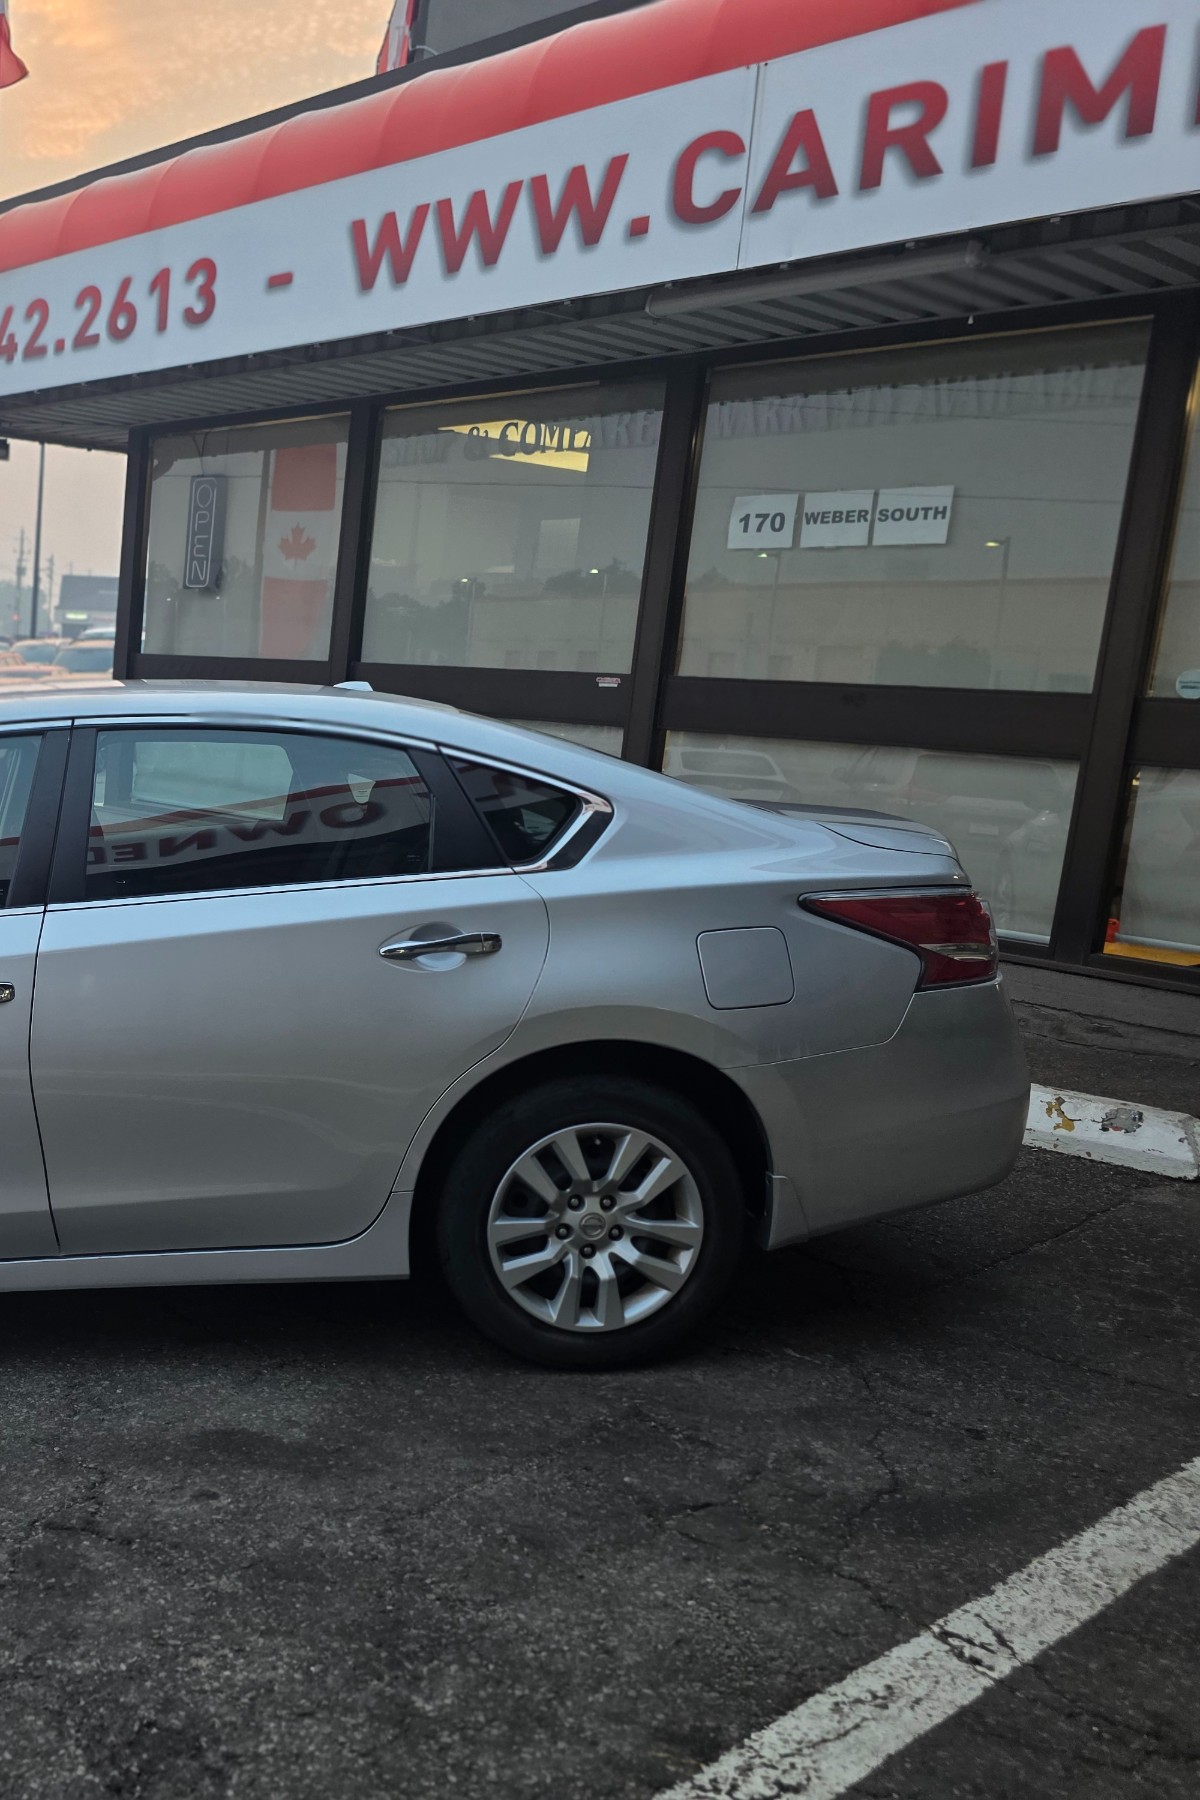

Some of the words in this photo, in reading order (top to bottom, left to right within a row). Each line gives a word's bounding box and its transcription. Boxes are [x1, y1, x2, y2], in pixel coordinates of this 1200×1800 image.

[352, 22, 1200, 291] WWW.CARIM
[191, 484, 213, 581] OPEN
[738, 512, 786, 534] 170
[804, 509, 869, 525] WEBER
[877, 505, 948, 523] SOUTH
